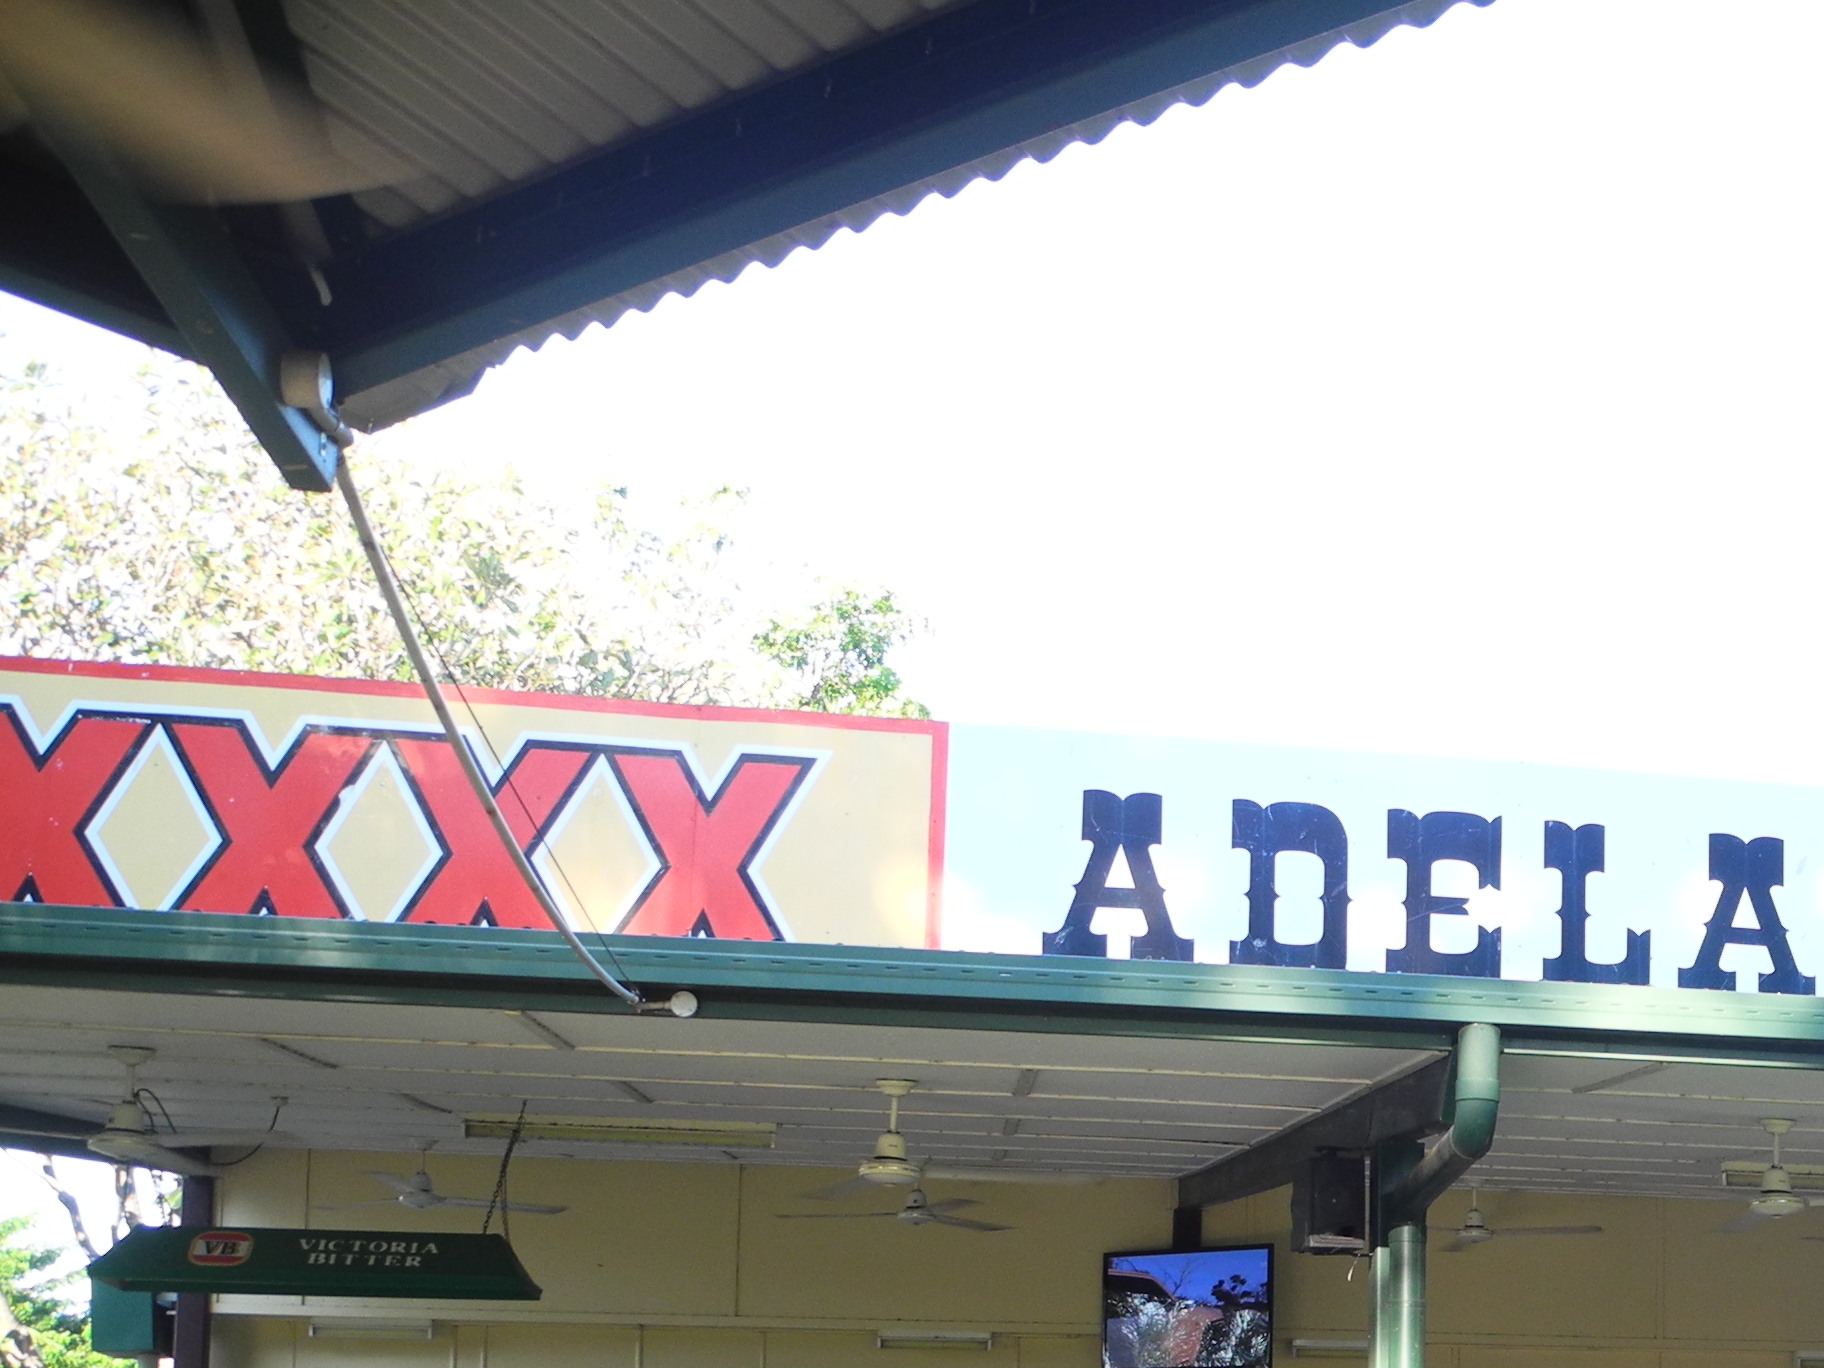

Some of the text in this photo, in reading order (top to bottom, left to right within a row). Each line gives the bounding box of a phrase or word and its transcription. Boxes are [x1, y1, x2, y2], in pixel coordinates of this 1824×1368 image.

[204, 1240, 238, 1256] VB
[300, 1238, 439, 1254] VICTORIA
[307, 1252, 423, 1267] BITTER
